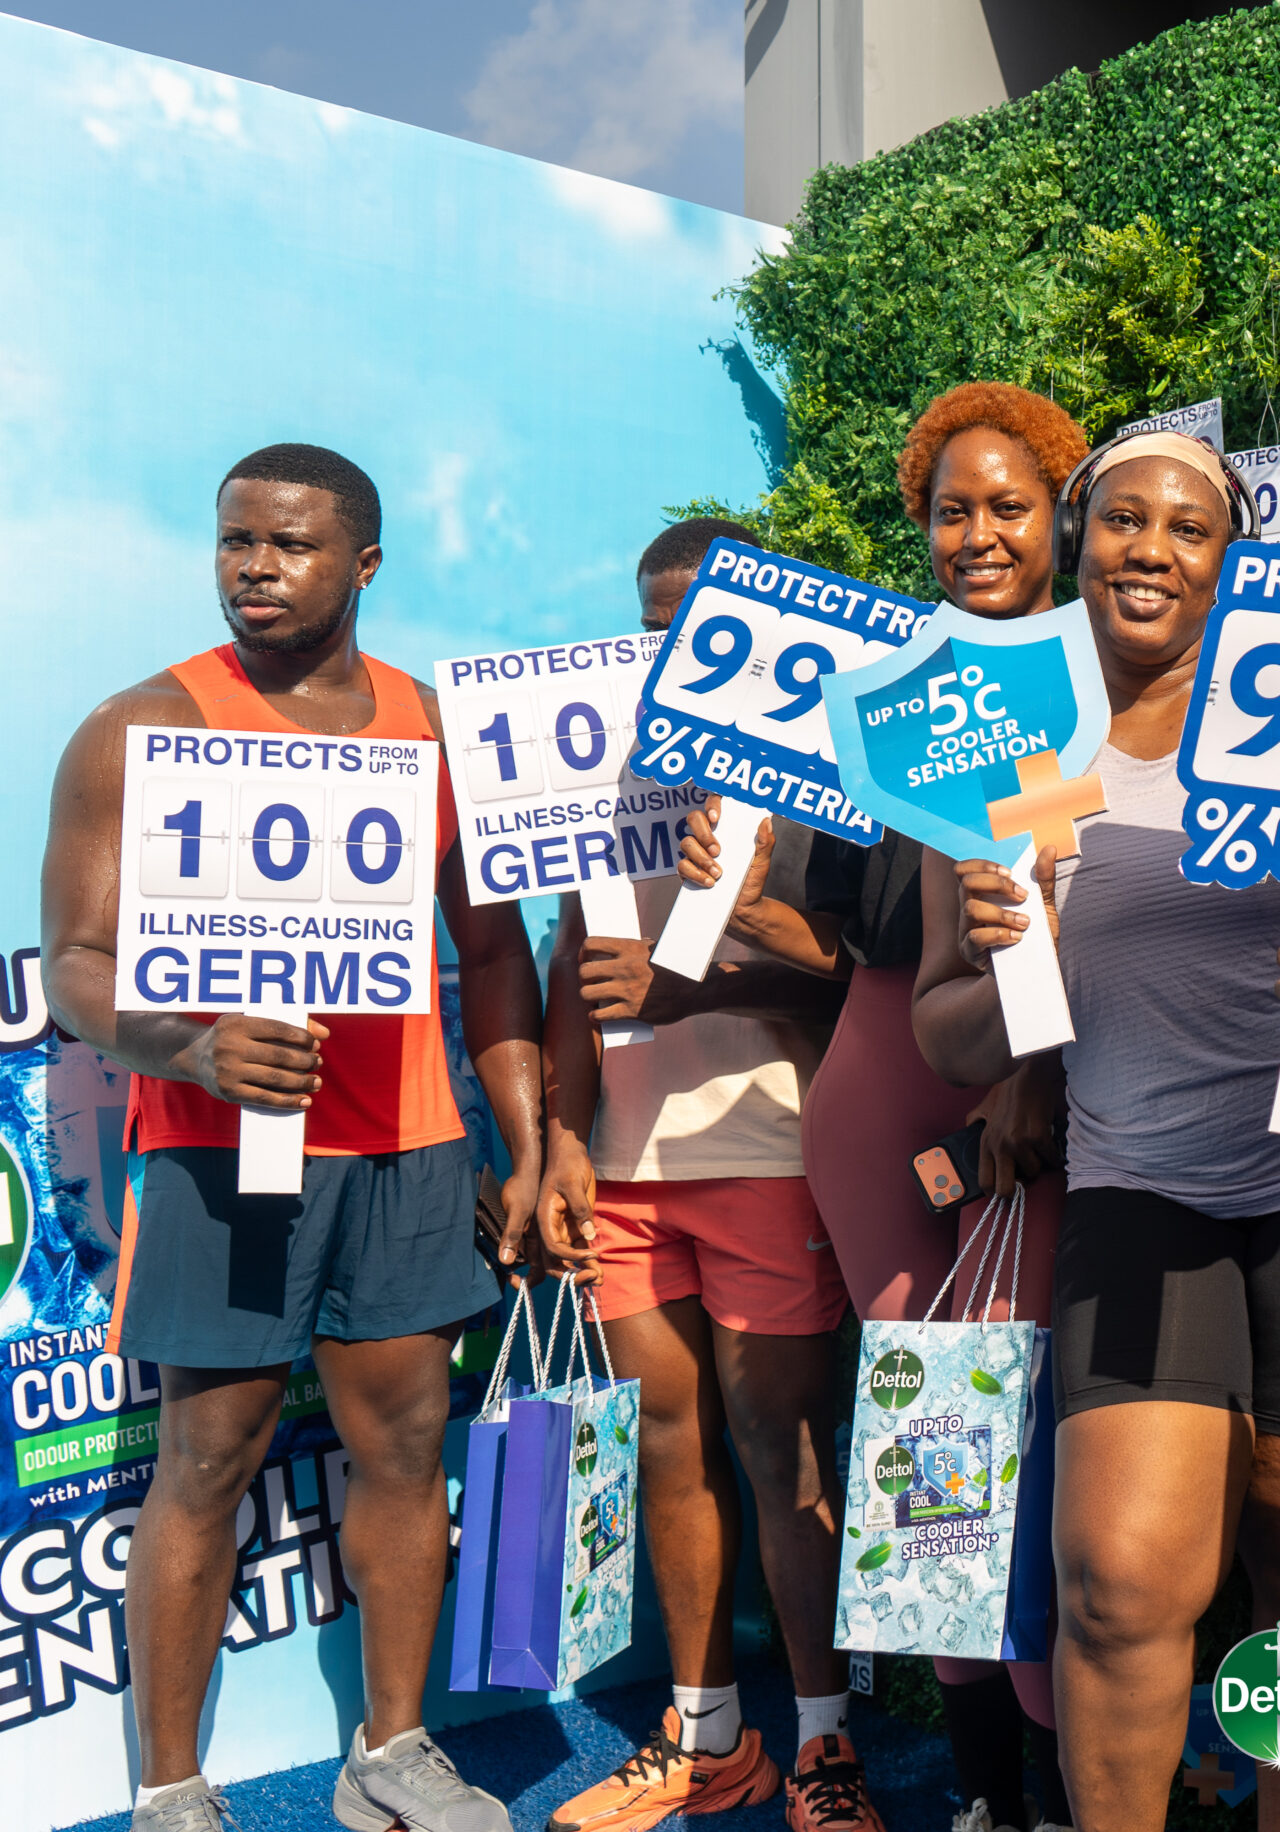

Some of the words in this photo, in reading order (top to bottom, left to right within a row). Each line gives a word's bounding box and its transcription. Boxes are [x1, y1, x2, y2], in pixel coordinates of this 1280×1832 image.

[1198, 401, 1217, 413] FROM
[1199, 412, 1207, 420] UP
[1209, 409, 1218, 417] TO
[709, 548, 866, 620] PROTECT
[866, 598, 930, 638] FR
[450, 639, 636, 687] PROTECTS
[679, 615, 836, 722] 99
[866, 707, 893, 727] UP
[896, 698, 925, 718] TO
[146, 734, 362, 772] PROTECTS
[369, 745, 418, 760] FROM
[478, 696, 640, 782] 10
[907, 729, 1048, 787] SENSATION
[926, 719, 1020, 759] COOLER
[369, 761, 391, 774] UP
[396, 762, 419, 776] TO
[641, 717, 692, 774] %
[704, 749, 873, 834] BACTERIA
[475, 786, 708, 837] ILLNESS-CAUSING
[164, 800, 402, 885] 100
[1196, 798, 1257, 873] %
[139, 913, 413, 941] ILLNESS-CAUSING
[135, 947, 412, 1007] GERMS
[12, 1353, 159, 1430] COOL
[872, 1370, 922, 1389] Dettol
[910, 1418, 934, 1437] UP
[938, 1415, 963, 1432] TO
[24, 1440, 81, 1472] ODOUR
[85, 1421, 159, 1457] PROTECTI
[576, 1438, 597, 1461] Dettol
[30, 1483, 80, 1508] with
[87, 1462, 156, 1494] MENT
[877, 1463, 912, 1480] Dettol
[910, 1495, 931, 1508] COOL
[580, 1515, 598, 1538] Dettol
[916, 1519, 983, 1541] COOLER
